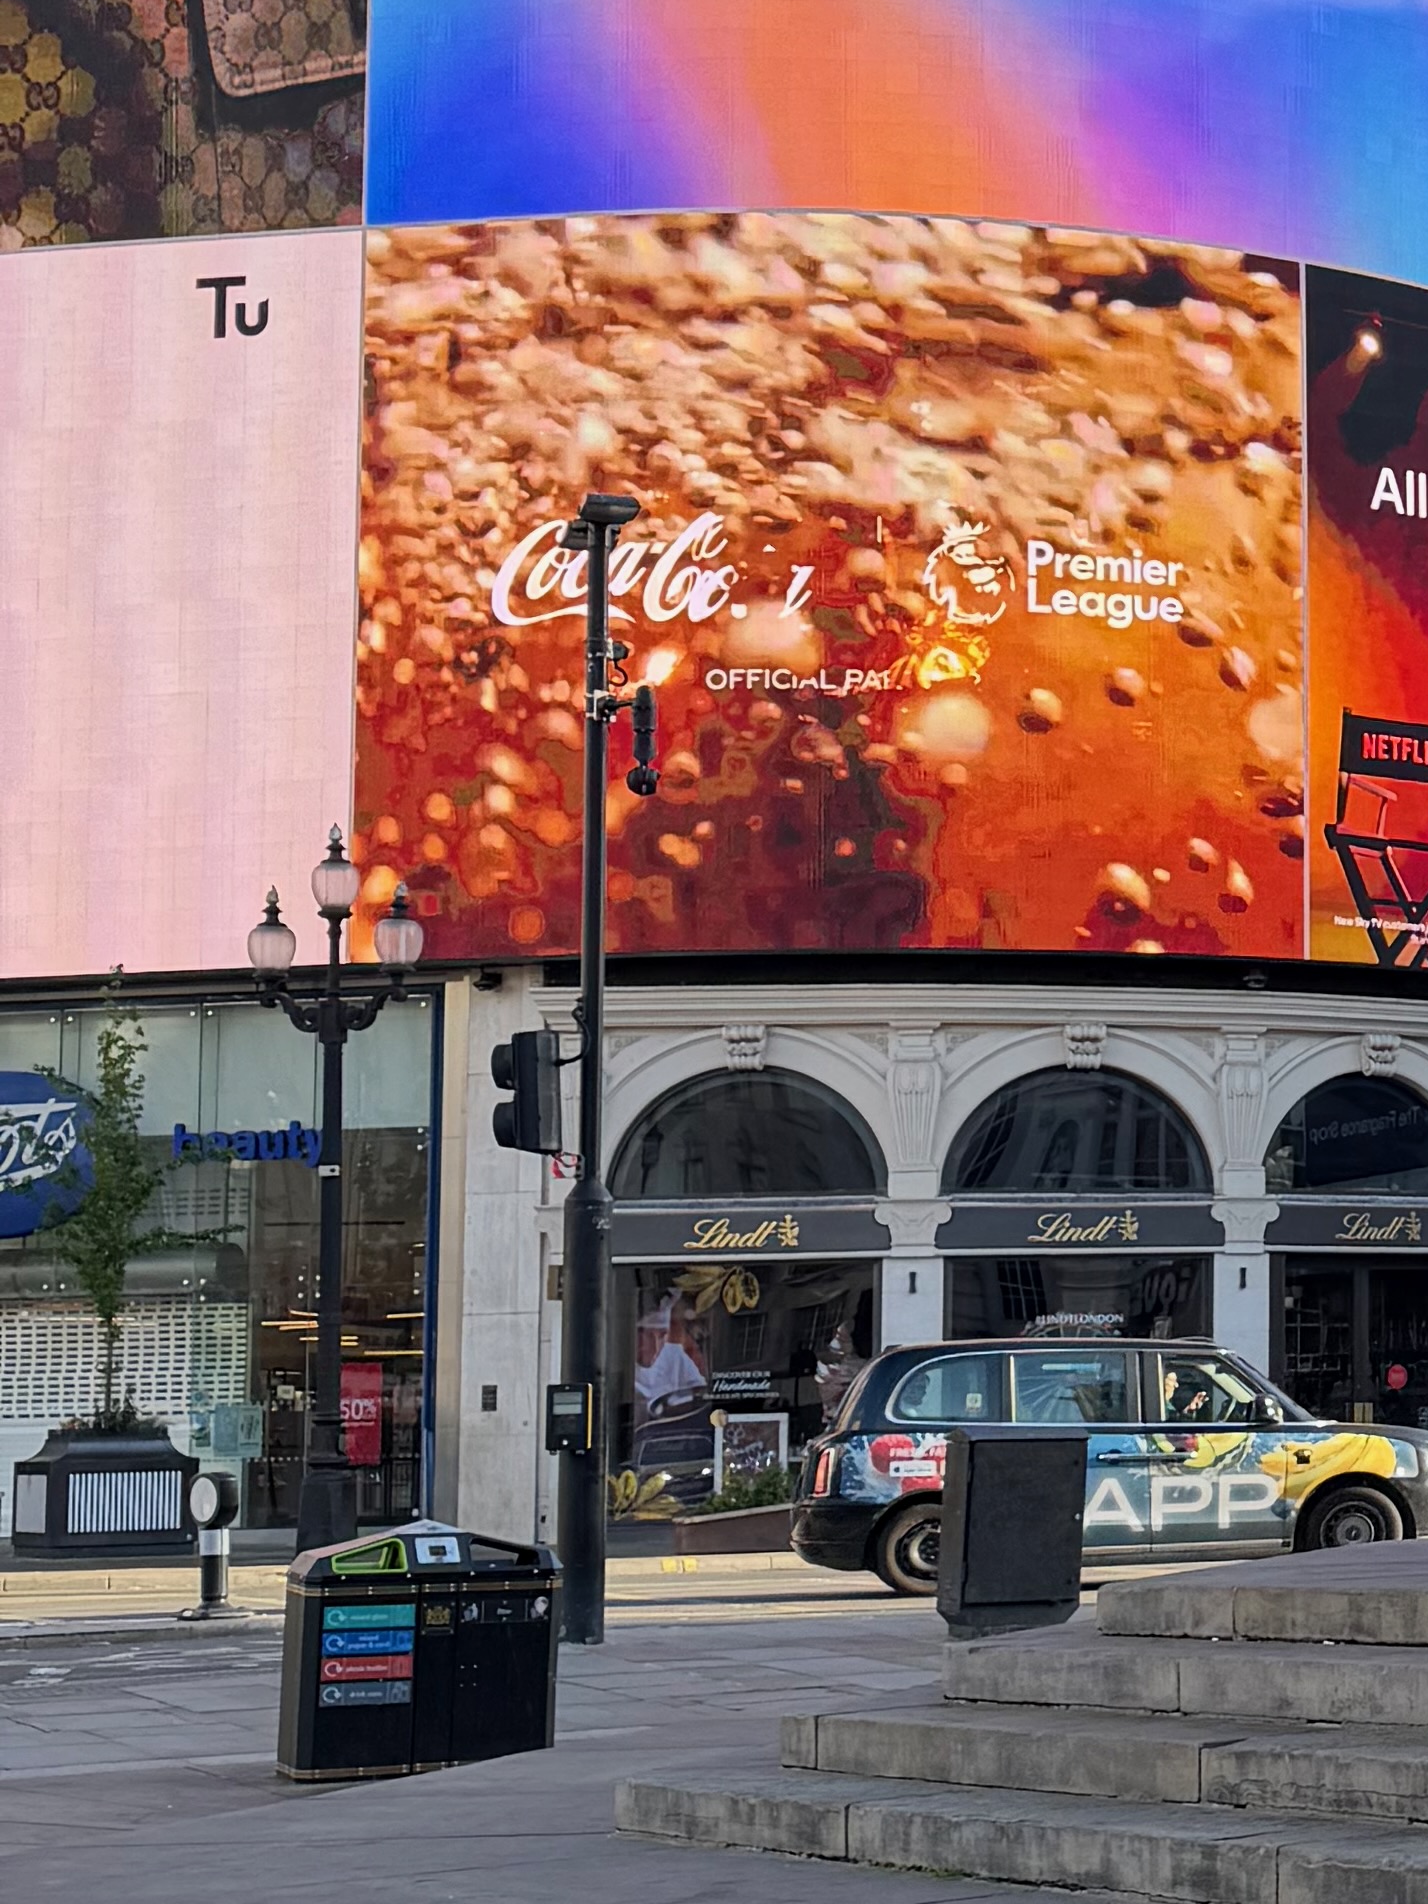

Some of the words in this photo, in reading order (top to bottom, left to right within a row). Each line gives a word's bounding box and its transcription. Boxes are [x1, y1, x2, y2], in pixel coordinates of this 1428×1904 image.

[196, 275, 270, 339] Tu
[1370, 467, 1428, 519] All
[1027, 539, 1185, 587] Premier
[1027, 577, 1185, 629] League
[172, 1119, 324, 1169] beauty
[684, 1217, 779, 1249] Lindt
[1027, 1212, 1120, 1243] Lindt
[1335, 1212, 1408, 1243] Lindt
